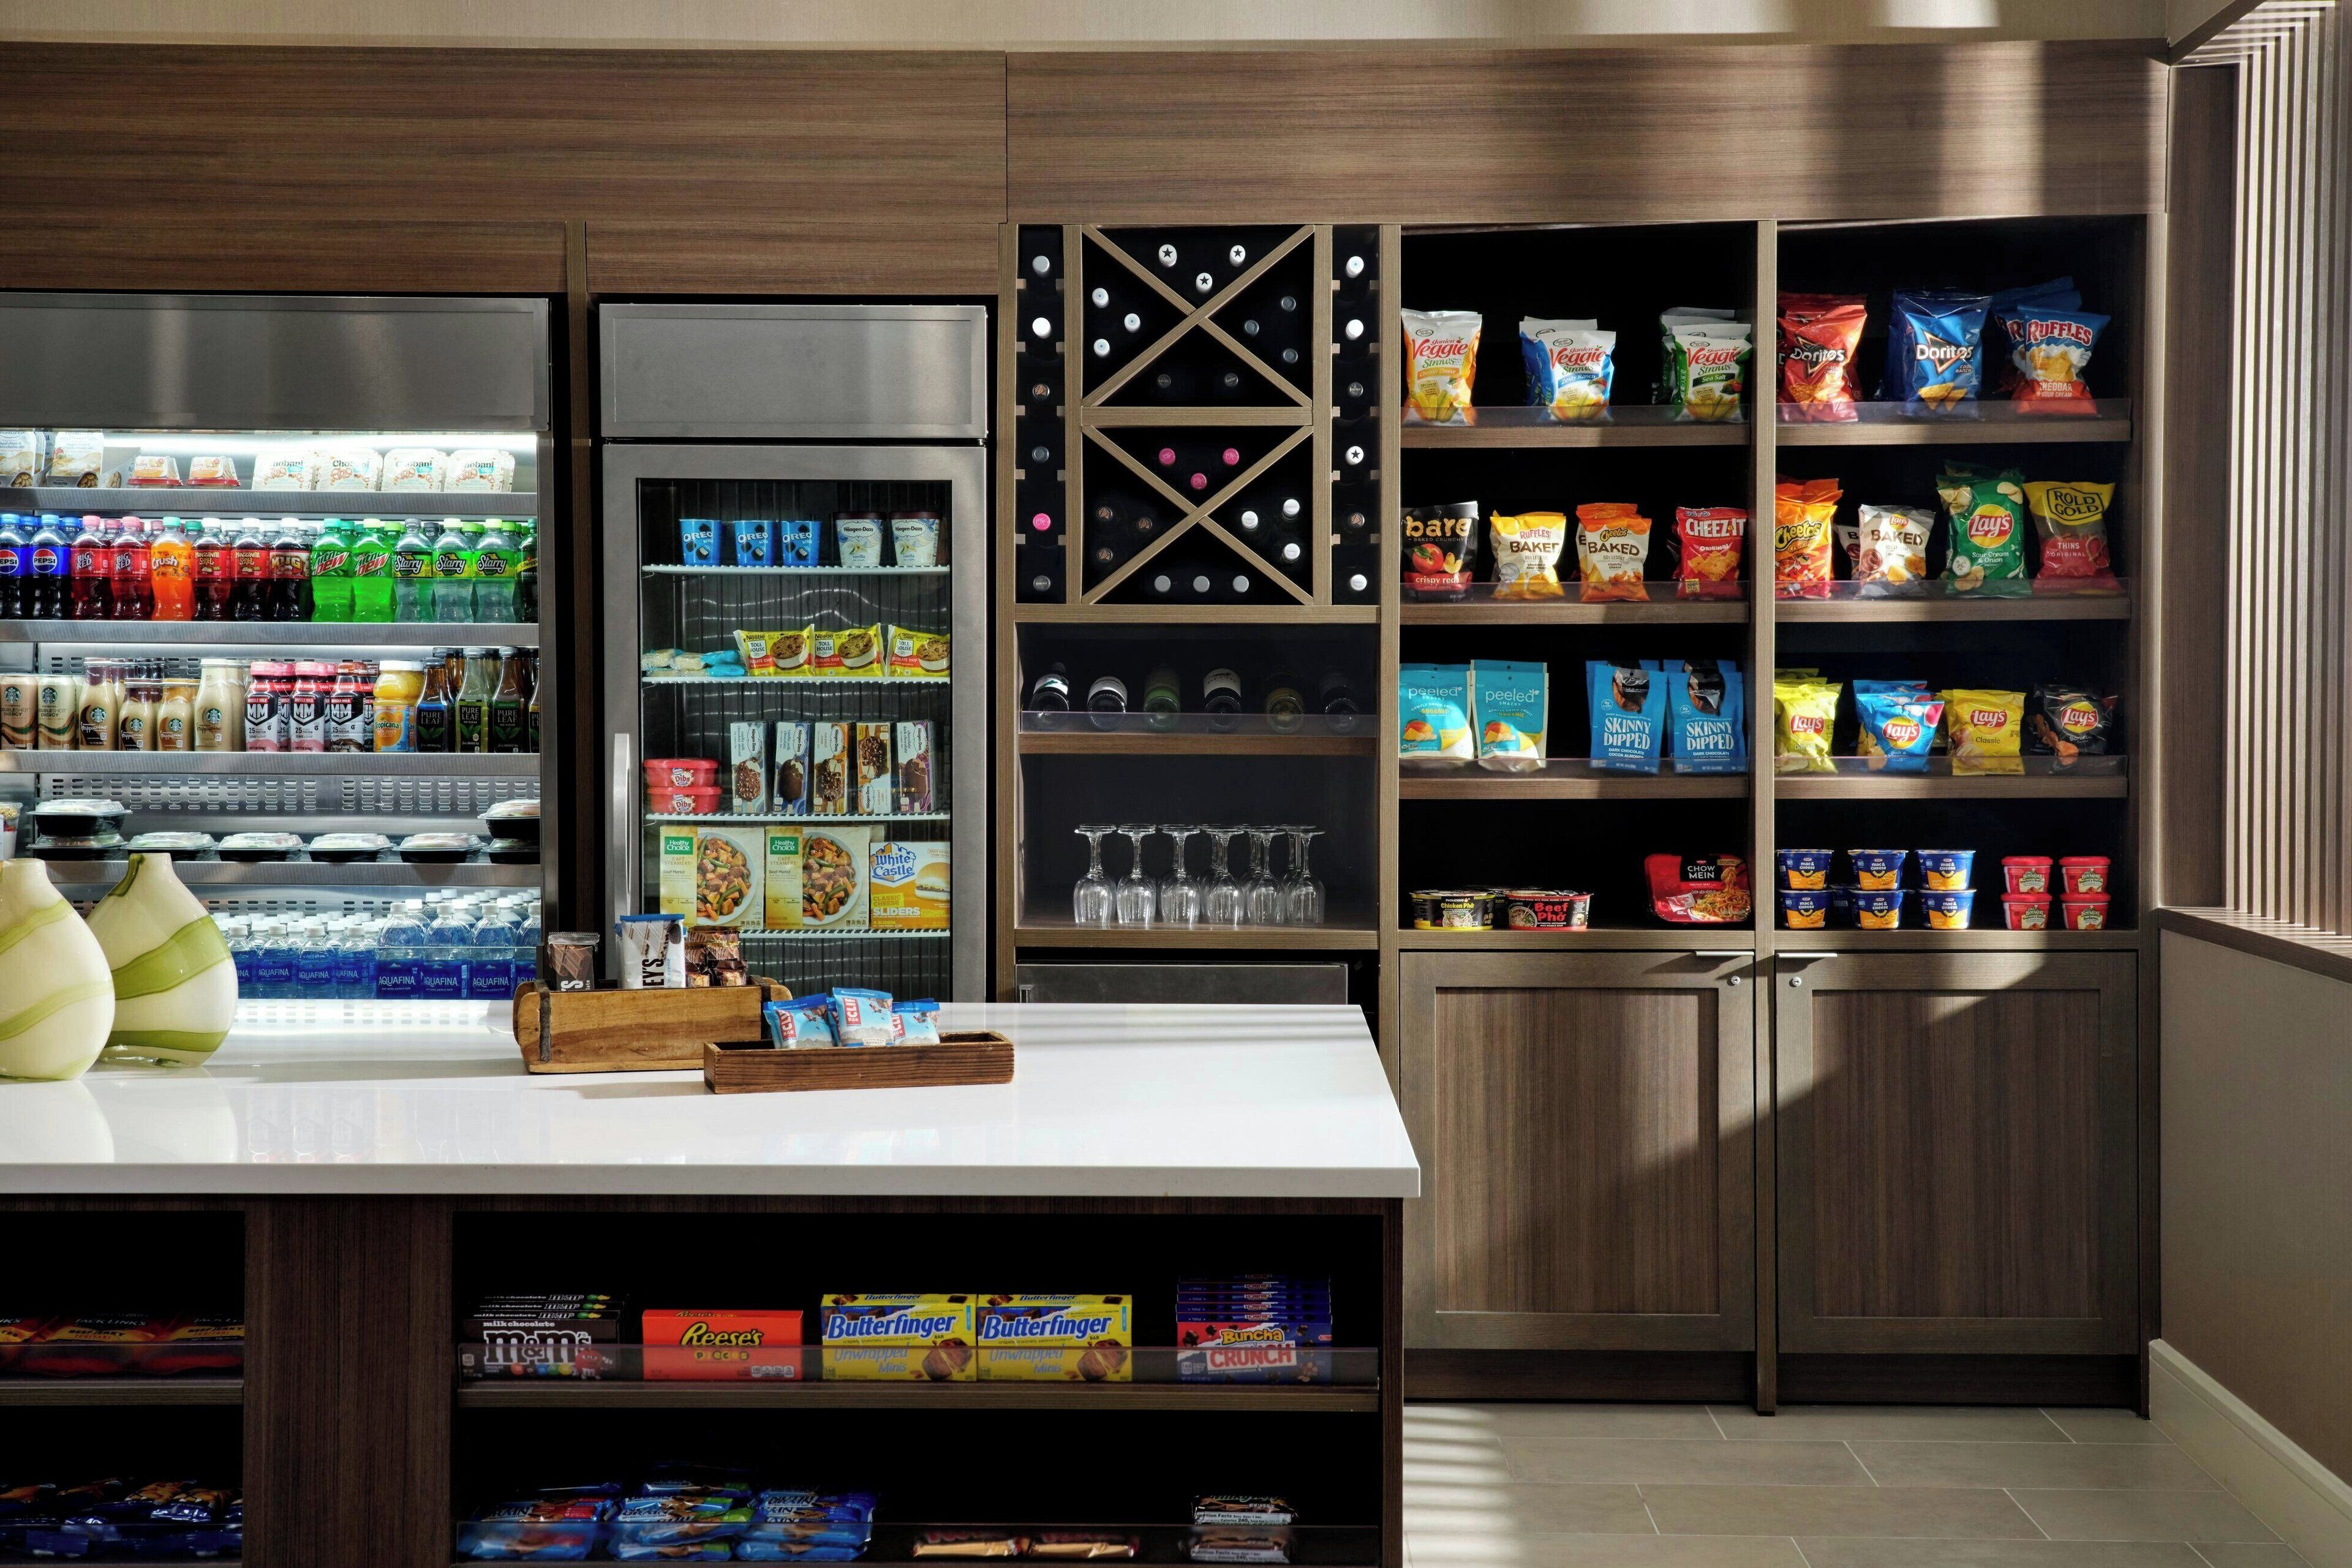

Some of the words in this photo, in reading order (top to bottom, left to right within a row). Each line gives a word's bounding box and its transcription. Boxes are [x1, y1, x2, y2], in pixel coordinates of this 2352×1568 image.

[2026, 319, 2092, 346] RUFFLES
[1412, 338, 1468, 360] Veggie
[1790, 348, 1845, 362] Doritos
[1917, 344, 1974, 360] Doritos
[1422, 358, 1455, 368] Straws
[1549, 347, 1607, 369] Veggie
[1698, 364, 1732, 375] Straws
[1561, 375, 1577, 385] Zesty
[2054, 491, 2095, 506] ROLD
[2055, 503, 2099, 517] GOLD
[1405, 516, 1472, 537] bare
[1520, 529, 1550, 539] RUFFLES
[1970, 515, 2011, 538] Lay's
[683, 531, 713, 542] OREO
[738, 532, 768, 543] OREO
[782, 532, 812, 543] OREO
[1600, 527, 1628, 542] Cheetos
[1775, 521, 1822, 550] Cheetos
[1871, 530, 1923, 546] BAKED
[1588, 541, 1640, 556] BAKED
[78, 552, 91, 562] BIG
[116, 552, 130, 562] BIG
[152, 556, 178, 570] Crush
[272, 557, 301, 570] MUG
[394, 555, 423, 574] Starry
[435, 555, 466, 574] Starry
[478, 555, 507, 573] Starry
[77, 560, 92, 570] RED
[116, 560, 131, 570] RED
[1408, 687, 1458, 699] peeled
[1485, 689, 1534, 703] peeled
[1793, 715, 1823, 733] Lay's
[1973, 710, 2005, 727] Lay's
[2062, 708, 2095, 726] Lay's
[1605, 717, 1651, 734] SKINNY
[1686, 721, 1733, 736] SKINNY
[1885, 724, 1918, 742] Lay's
[1604, 733, 1651, 750] DIPPED
[1687, 734, 1734, 750] DIPPED
[875, 854, 911, 866] White
[873, 866, 914, 878] Castle
[873, 907, 920, 916] SLIDERS
[1534, 902, 1569, 911] Beef
[258, 968, 289, 977] AQUAFINA
[298, 971, 329, 980] AQUAFINA
[379, 976, 415, 986] AQUAFINA
[424, 977, 459, 986] AQUAFINA
[472, 977, 509, 987] AQUAFINA
[845, 998, 858, 1017] CLIF
[680, 1321, 764, 1346] Reese's
[827, 1314, 957, 1340] Butterfinger
[983, 1314, 1114, 1340] Butterfinger
[1220, 1329, 1284, 1345] Buncha
[834, 1343, 910, 1362] Unwrapped
[989, 1344, 1065, 1363] Unwrapped
[1209, 1343, 1292, 1368] CRUNCH
[878, 1362, 908, 1373] Minis
[1033, 1363, 1062, 1373] Minis
